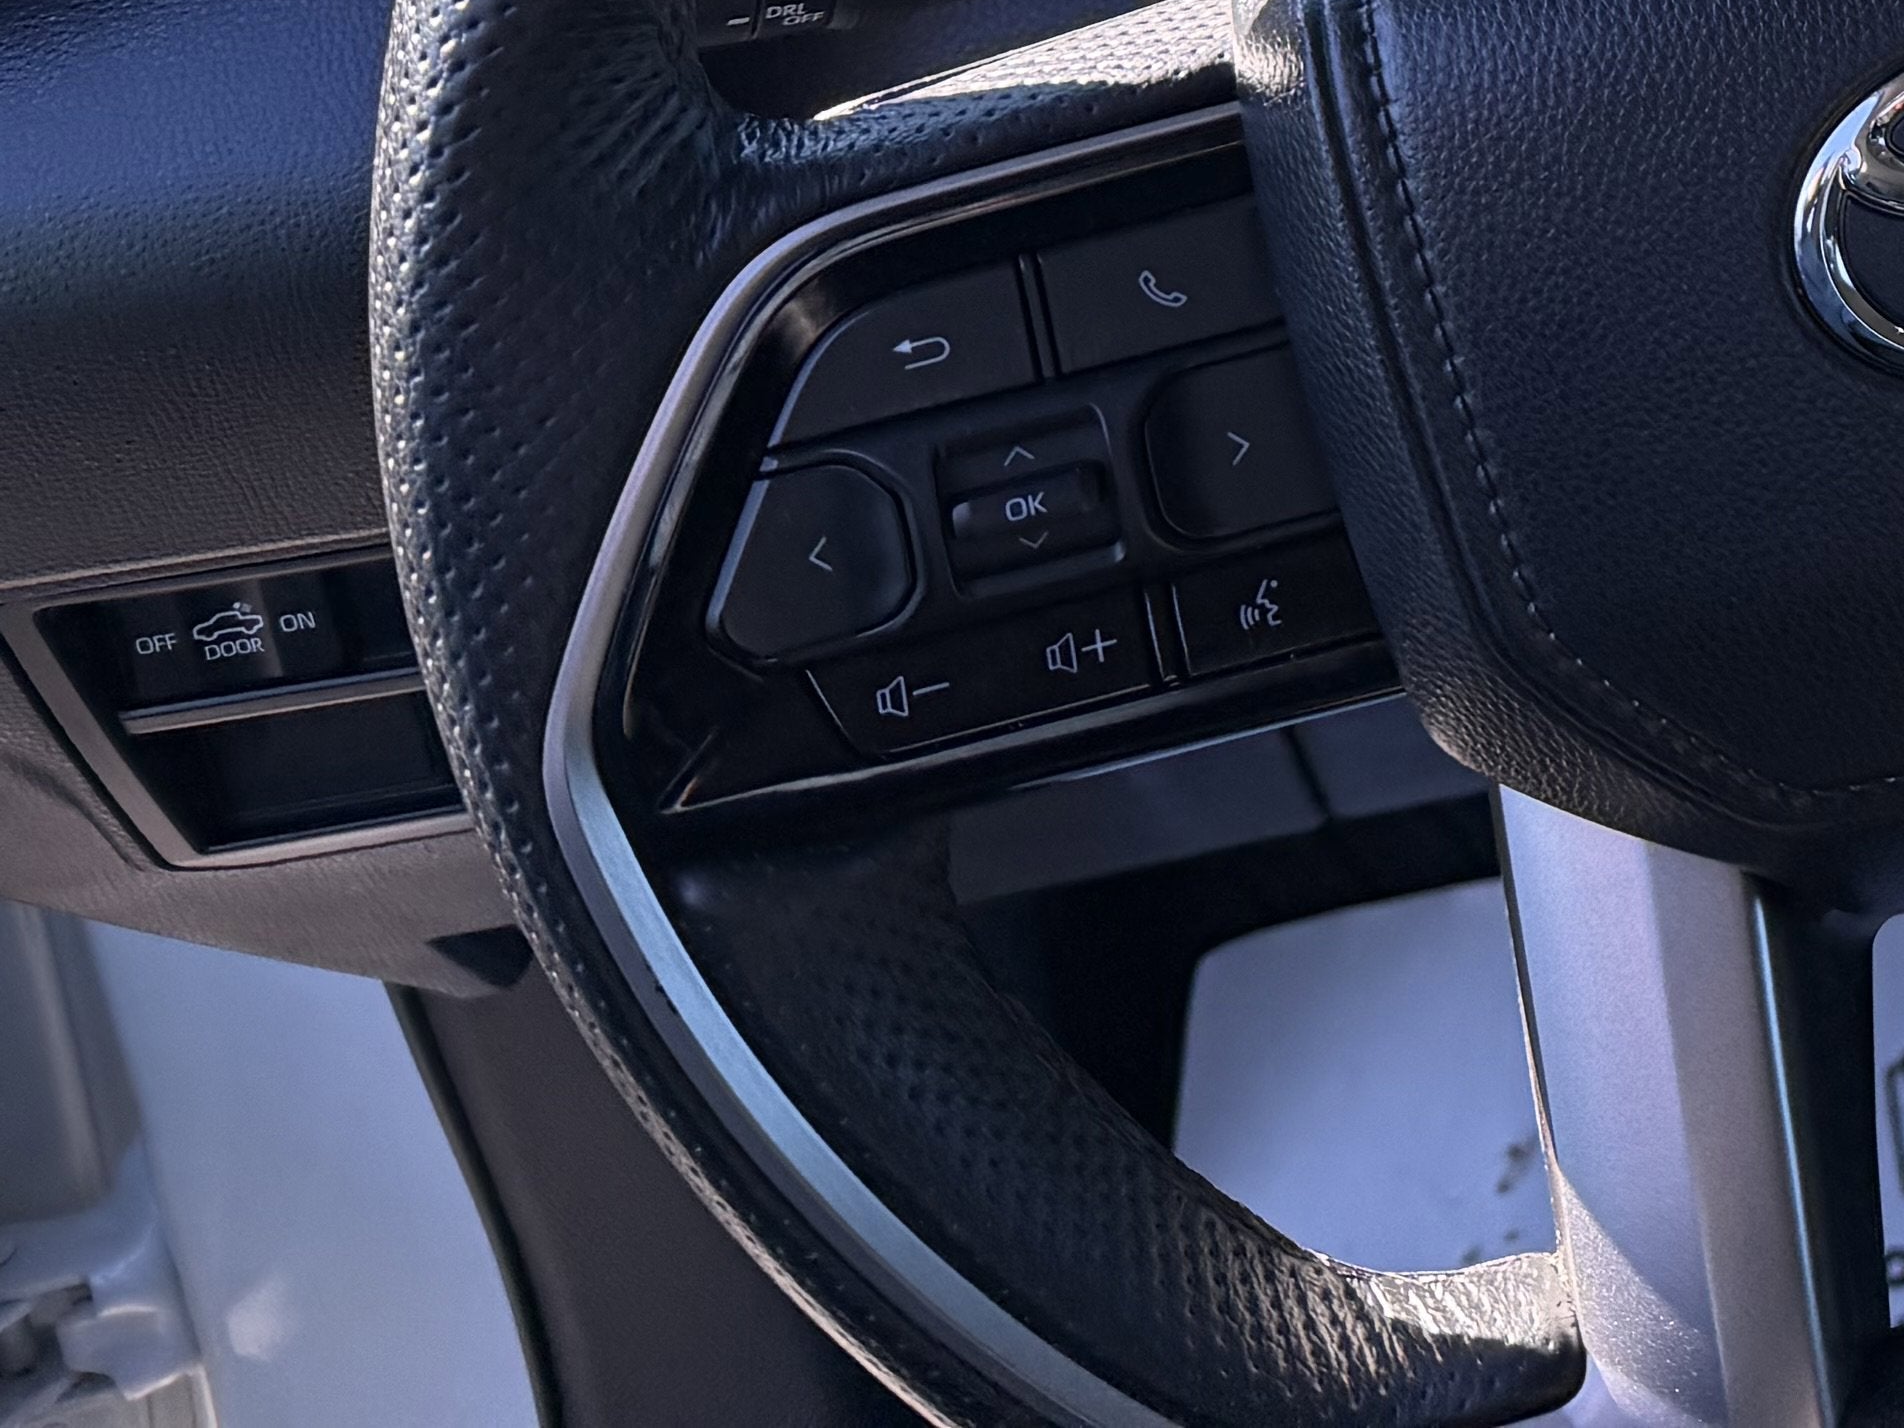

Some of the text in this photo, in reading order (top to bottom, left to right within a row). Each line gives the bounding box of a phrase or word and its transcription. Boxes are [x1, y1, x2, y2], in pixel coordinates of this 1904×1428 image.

[765, 2, 807, 19] DRL
[782, 11, 825, 26] OFF
[1005, 491, 1047, 522] OK
[279, 611, 317, 633] ON
[135, 633, 178, 655] OFF
[204, 637, 265, 661] DOOR
